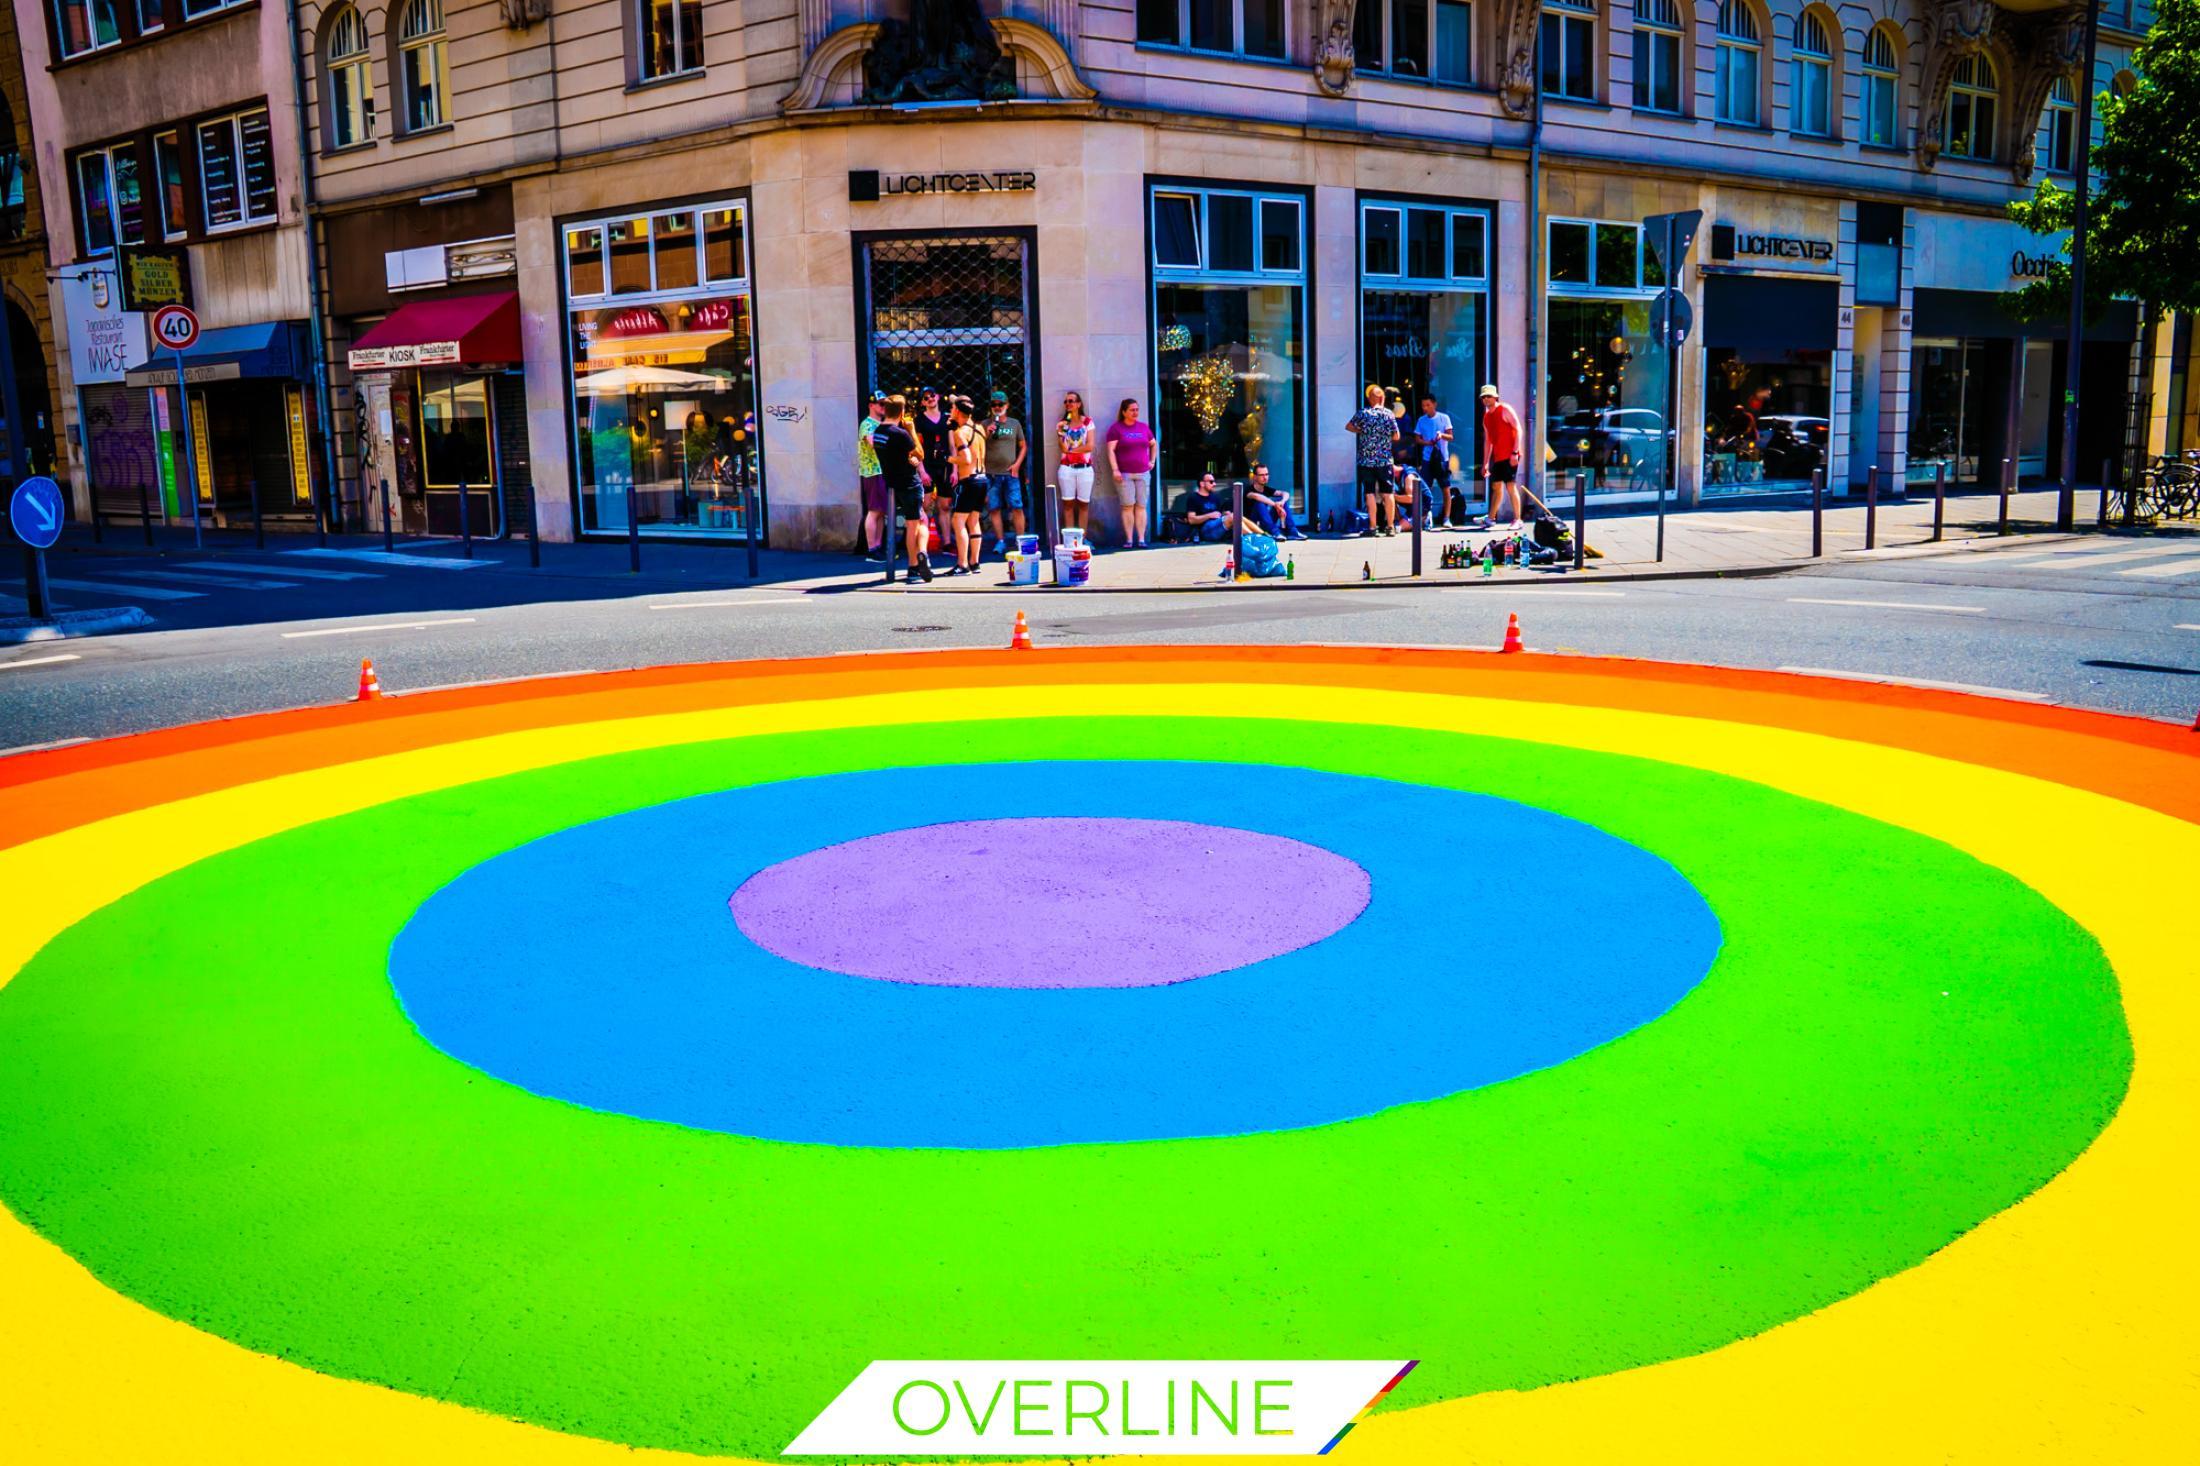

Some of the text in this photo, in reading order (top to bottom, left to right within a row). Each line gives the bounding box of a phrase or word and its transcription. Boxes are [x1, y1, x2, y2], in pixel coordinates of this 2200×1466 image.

[144, 270, 168, 278] GOLD
[164, 317, 190, 337] 40
[578, 321, 598, 331] LIVING
[579, 332, 592, 340] THE
[389, 350, 415, 362] KIOSK
